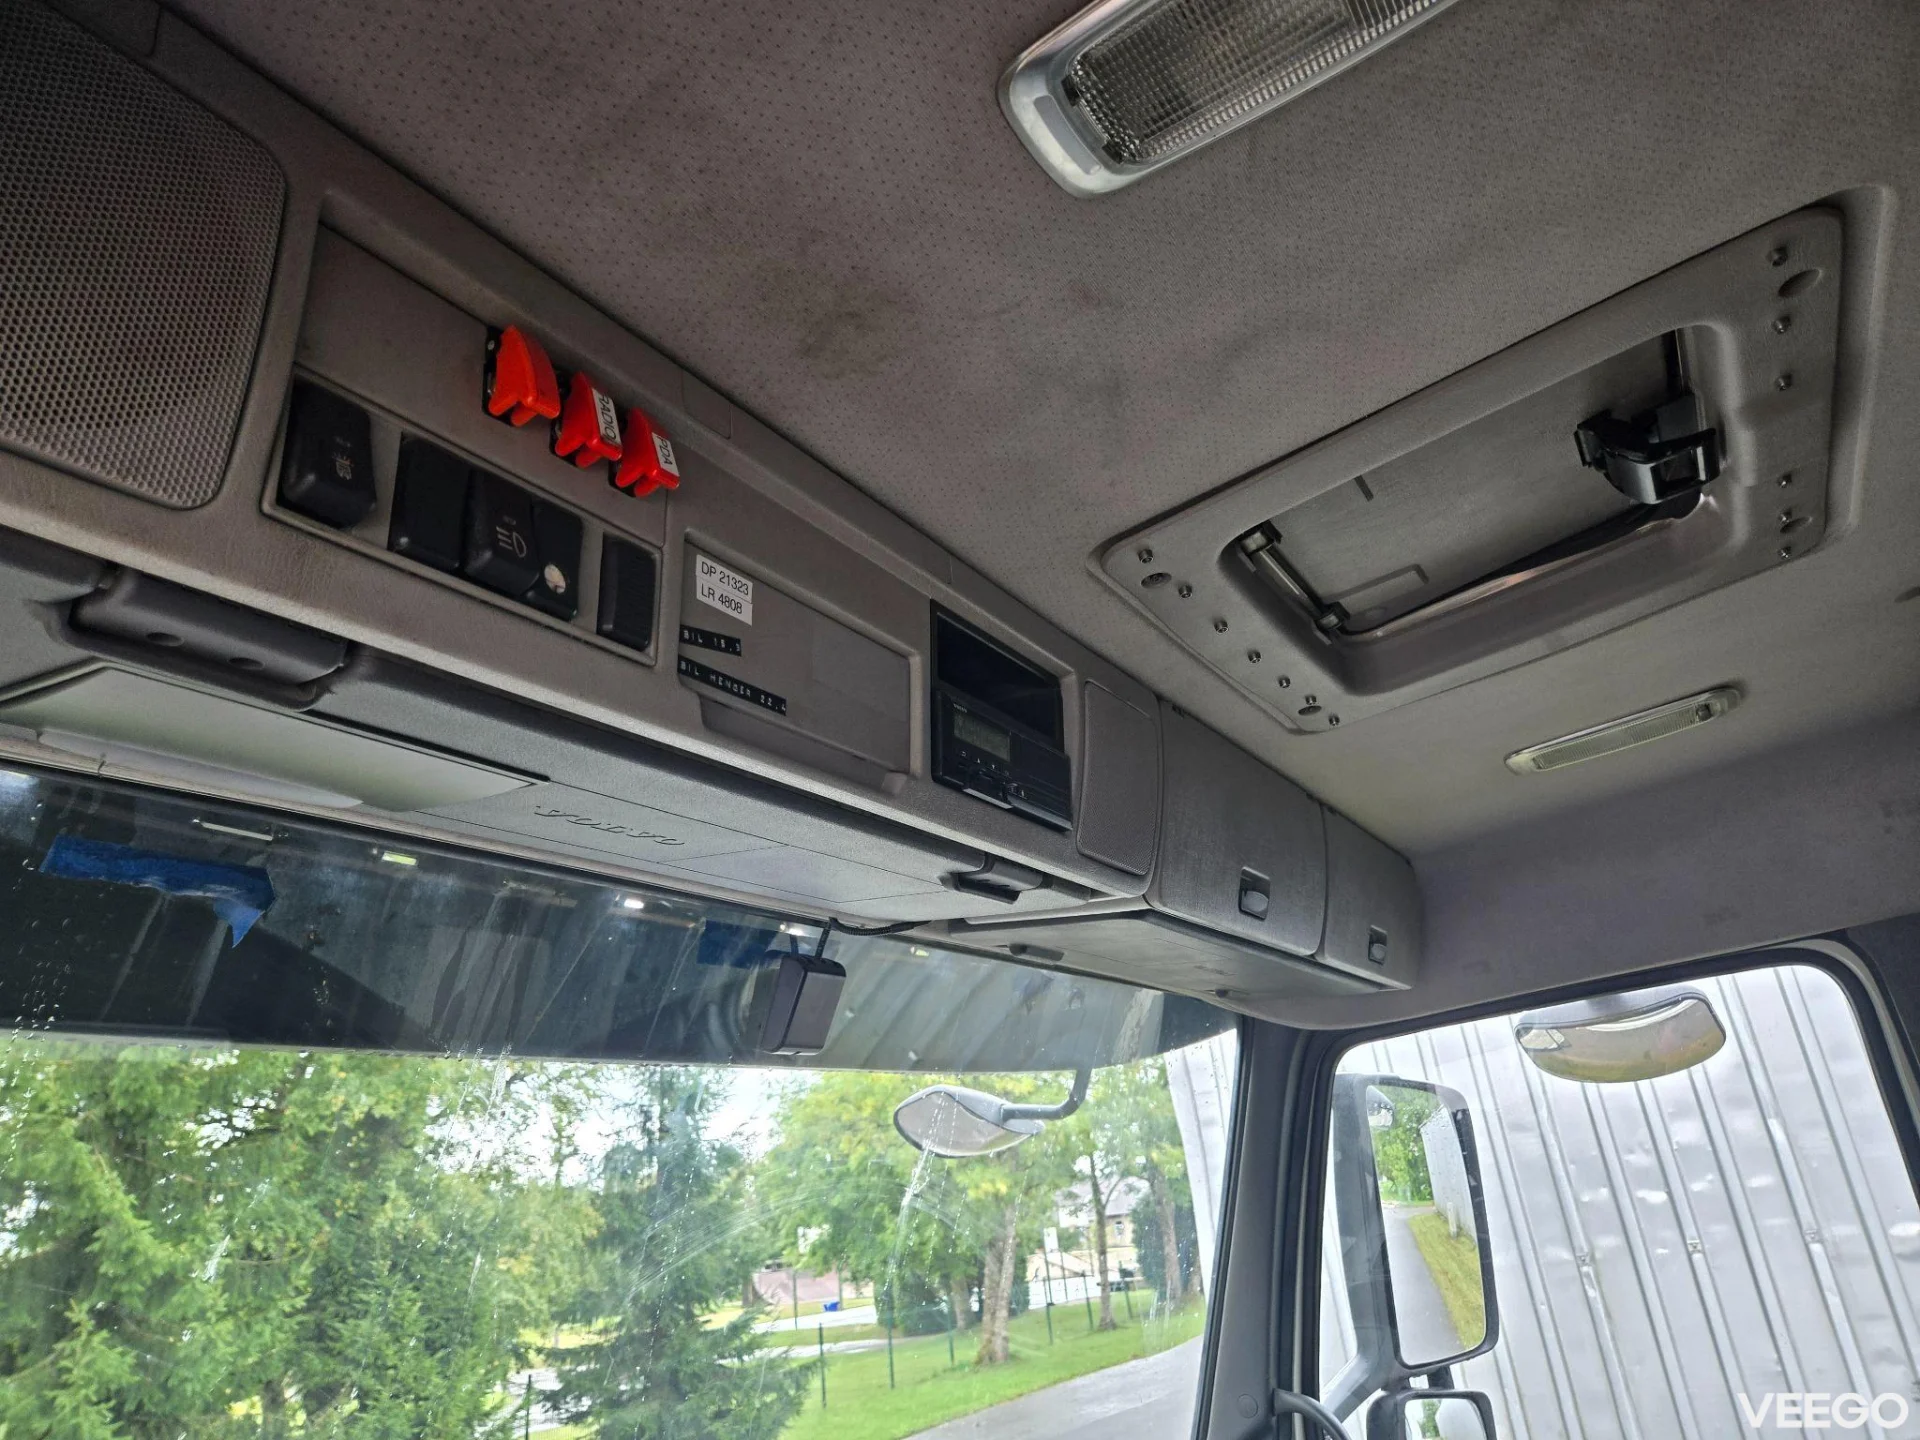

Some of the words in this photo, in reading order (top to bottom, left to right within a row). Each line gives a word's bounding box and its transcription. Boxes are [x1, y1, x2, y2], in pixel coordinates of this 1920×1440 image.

[701, 561, 717, 577] DP
[719, 570, 749, 596] 21323
[701, 583, 715, 602] LR
[718, 593, 743, 614] 4808
[534, 805, 686, 846] VOLVO
